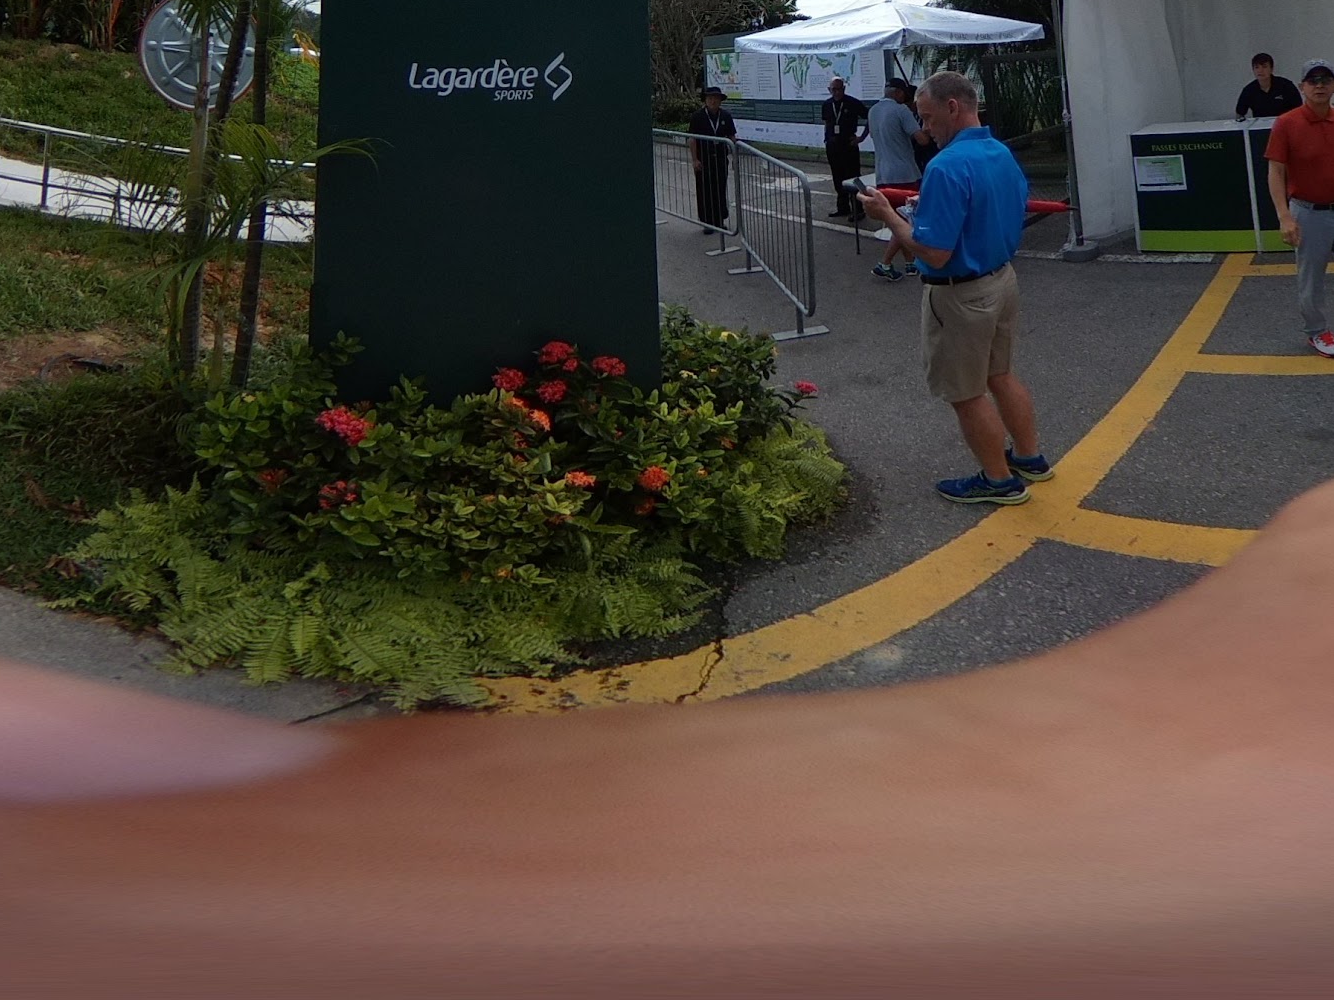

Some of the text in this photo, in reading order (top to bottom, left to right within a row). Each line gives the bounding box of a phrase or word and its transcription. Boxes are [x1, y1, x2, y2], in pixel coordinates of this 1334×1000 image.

[409, 59, 539, 96] Lagardère
[494, 89, 534, 101] SPORTS
[1151, 142, 1223, 152] PASSES EXCHANGE
